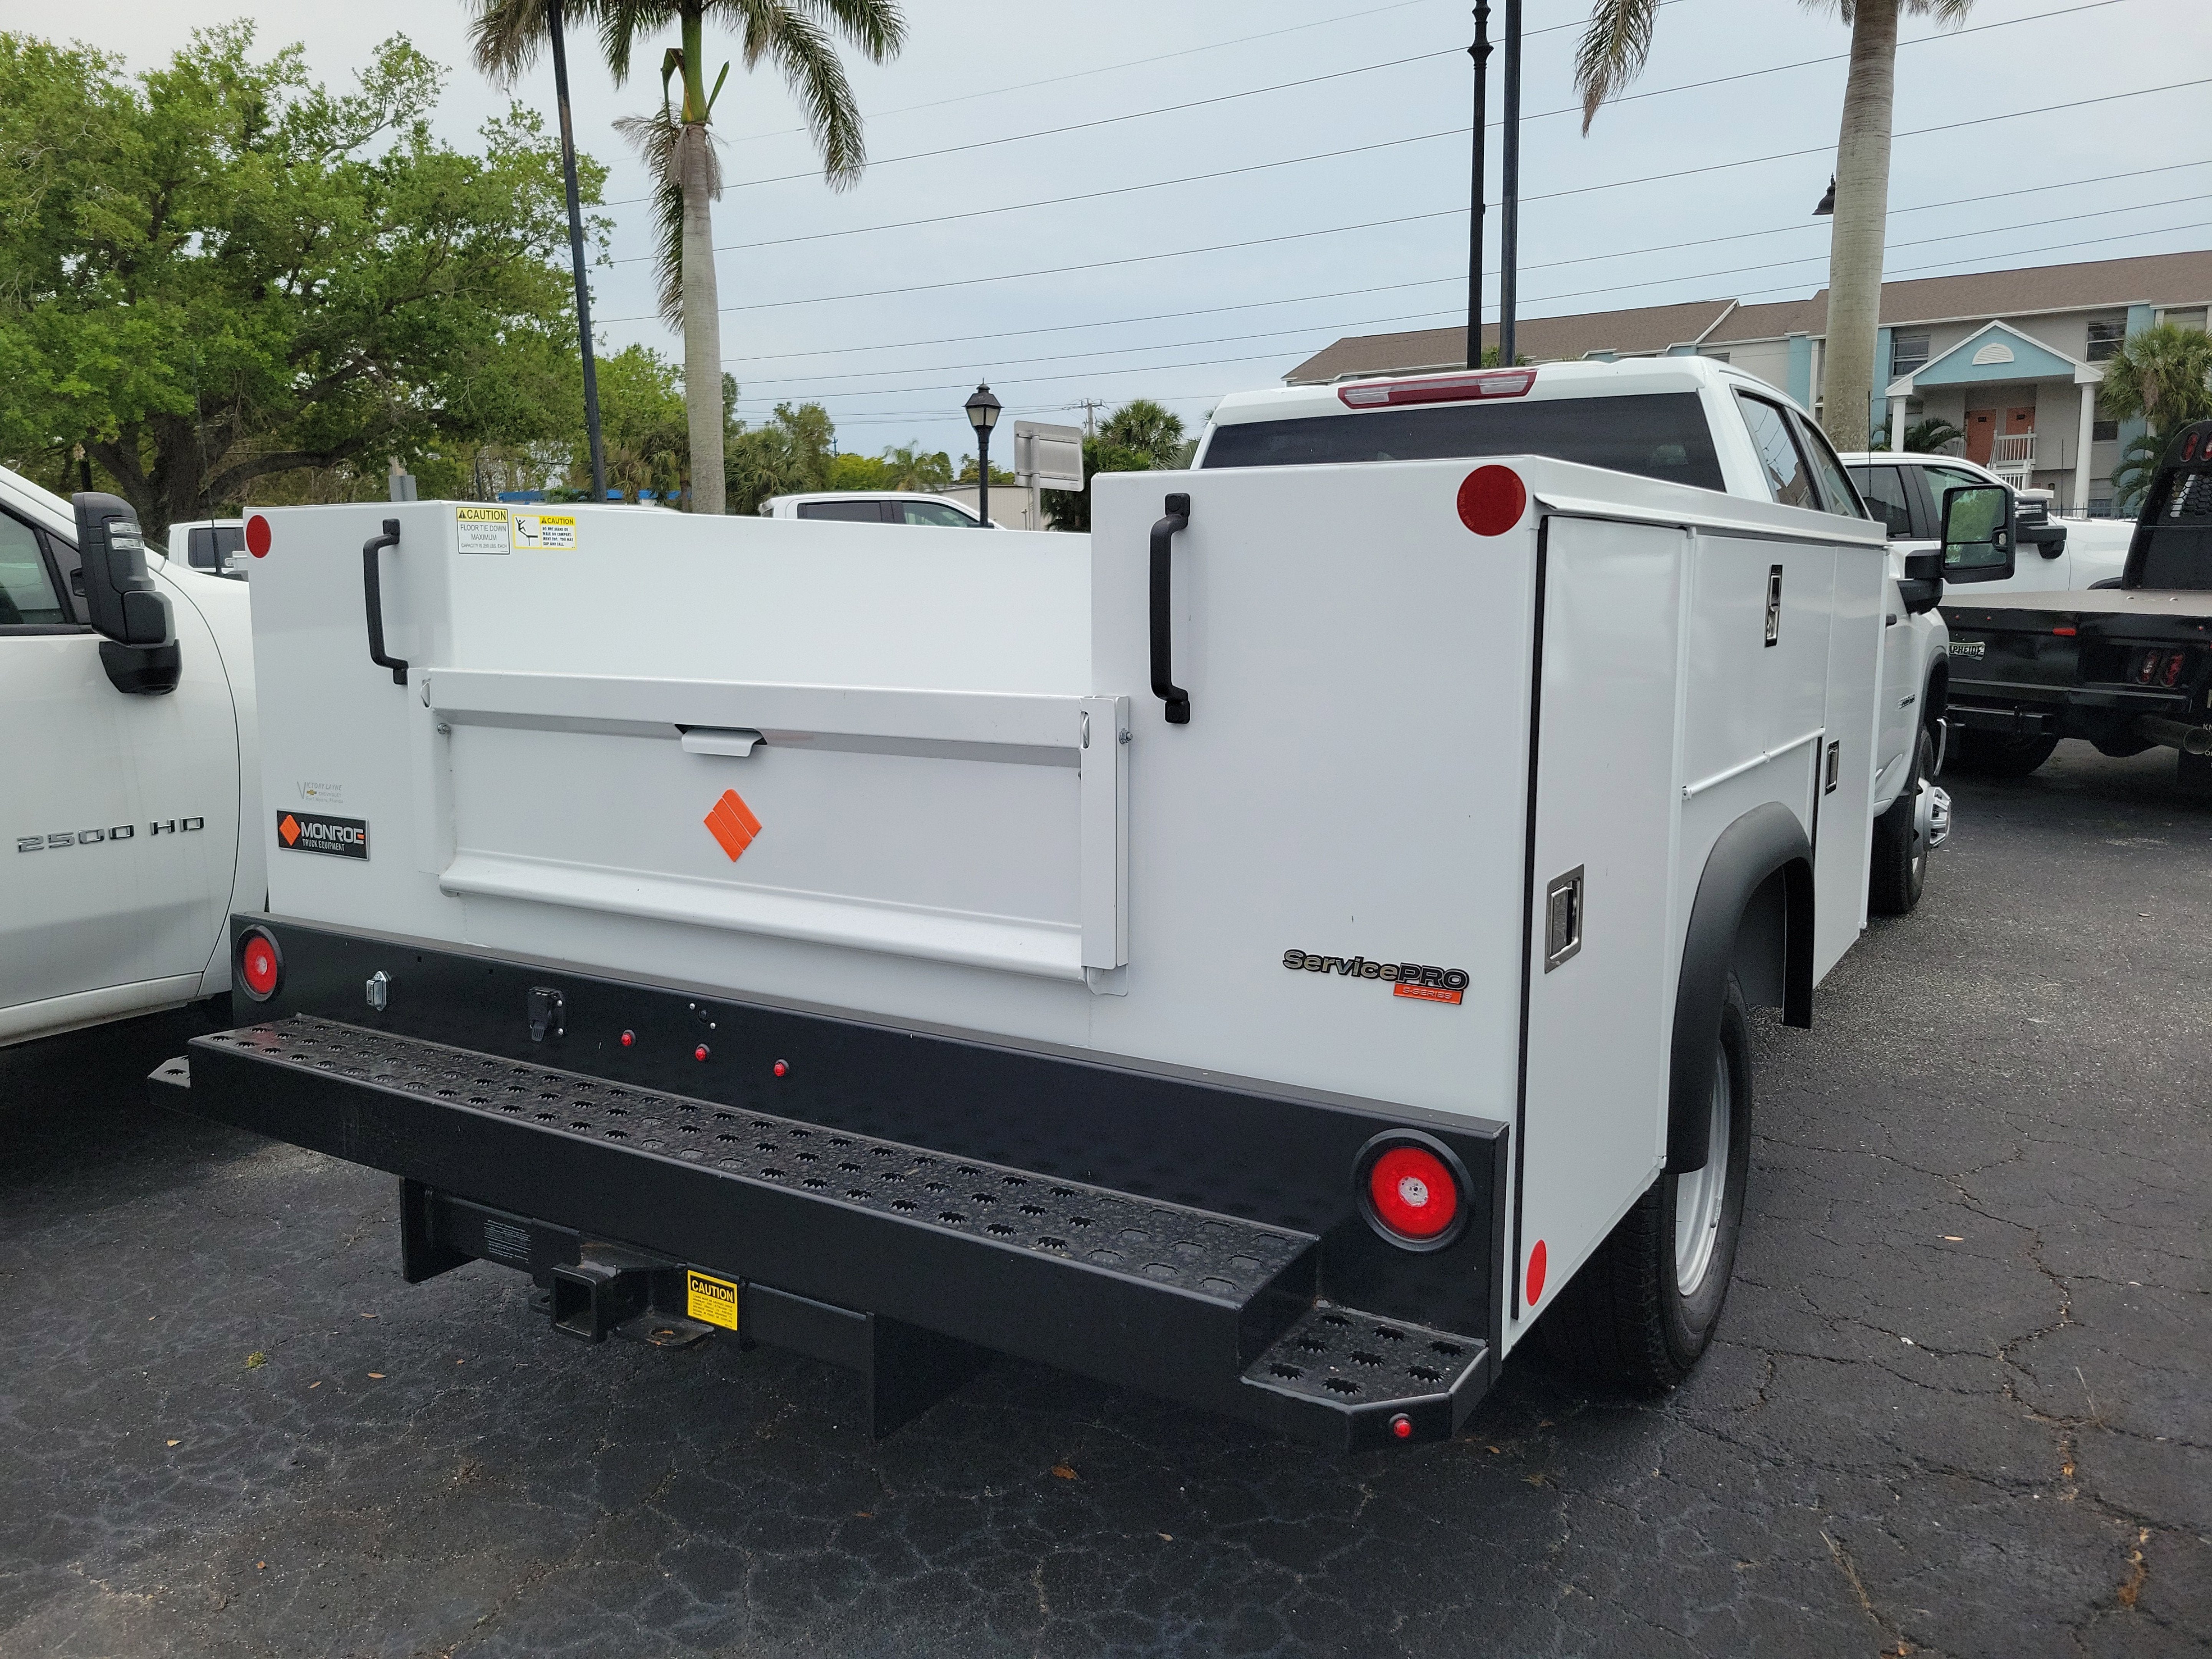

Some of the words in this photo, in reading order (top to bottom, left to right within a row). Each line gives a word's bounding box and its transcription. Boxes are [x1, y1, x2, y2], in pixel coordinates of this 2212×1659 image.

[467, 510, 506, 520] CAUTION
[297, 781, 324, 799] VICTORY
[17, 824, 134, 853] 2500
[150, 816, 204, 835] HD
[301, 821, 364, 844] MONROE
[302, 838, 318, 848] TRUCK
[319, 841, 345, 851] EQUIPMENT
[692, 1280, 733, 1302] CAUTION
